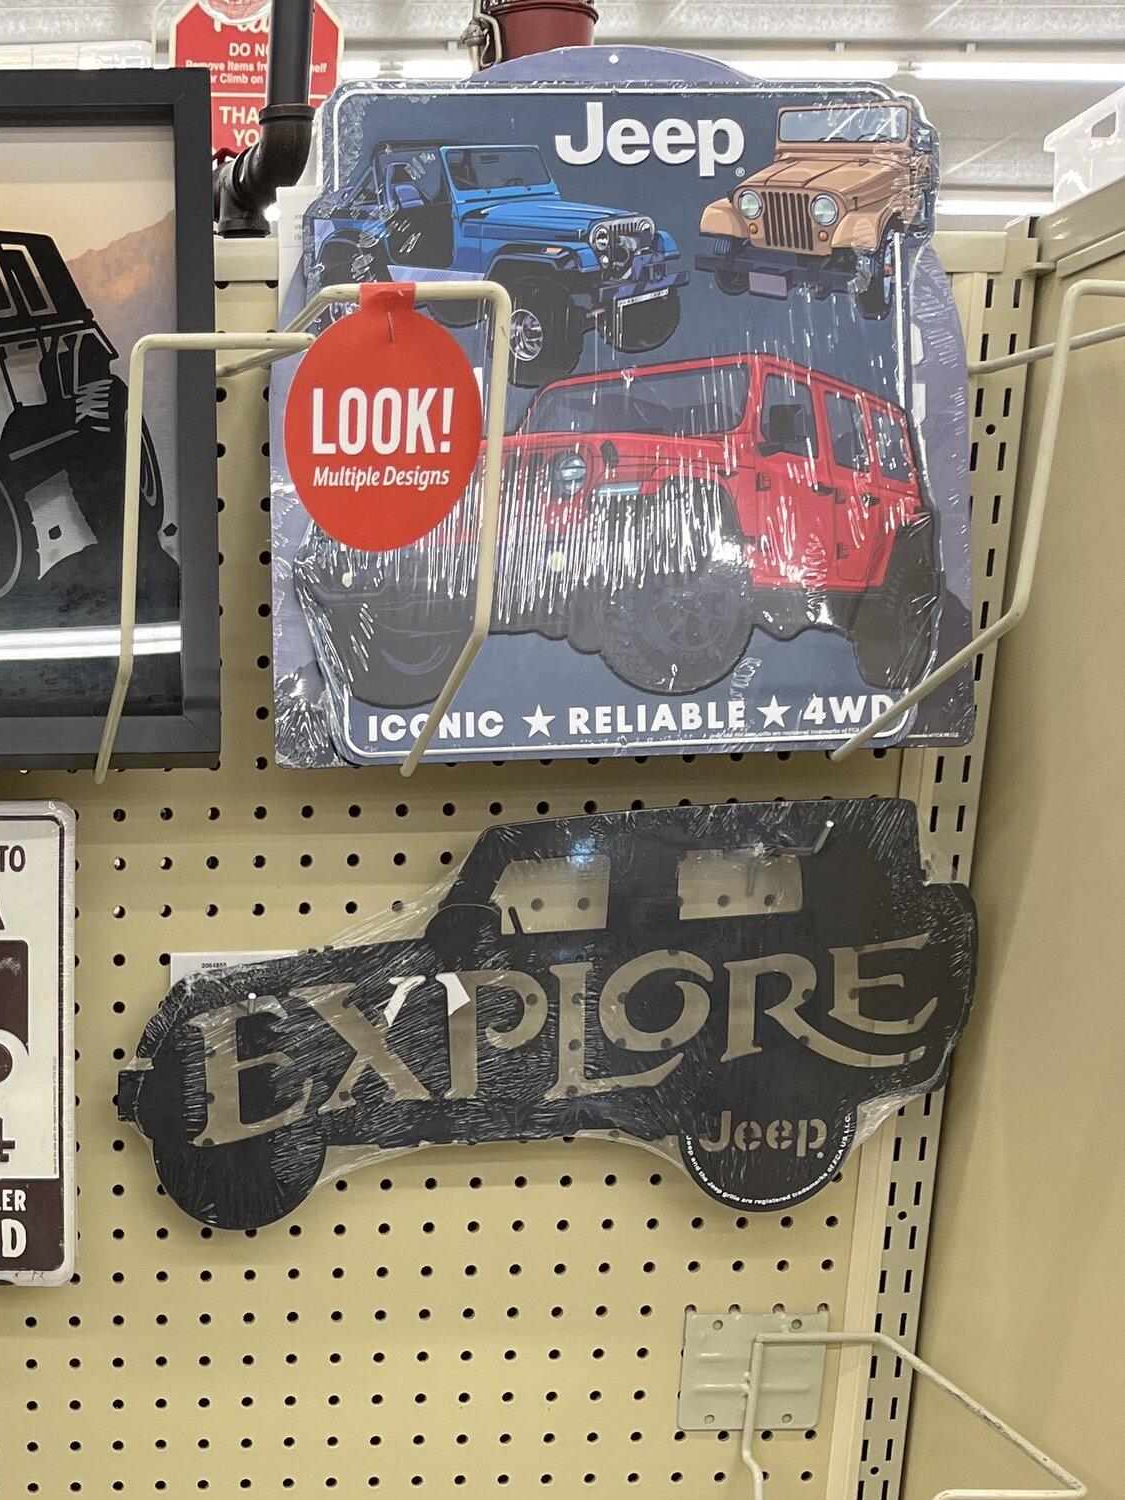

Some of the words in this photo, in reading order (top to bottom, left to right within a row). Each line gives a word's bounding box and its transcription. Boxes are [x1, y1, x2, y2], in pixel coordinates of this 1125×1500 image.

[227, 61, 254, 71] Items
[229, 43, 251, 57] DO
[220, 73, 248, 84] Climb
[250, 75, 263, 84] on
[219, 106, 260, 125] THA
[554, 101, 745, 179] Jeep
[311, 388, 453, 456] LOOK!
[312, 464, 380, 492] Multiple
[383, 464, 451, 493] Designs
[368, 710, 504, 742] ICONIC
[568, 700, 746, 736] RELIABLE
[803, 694, 895, 725] 4WD
[188, 933, 939, 1147] EXPLORE
[699, 1110, 828, 1157] Jeep
